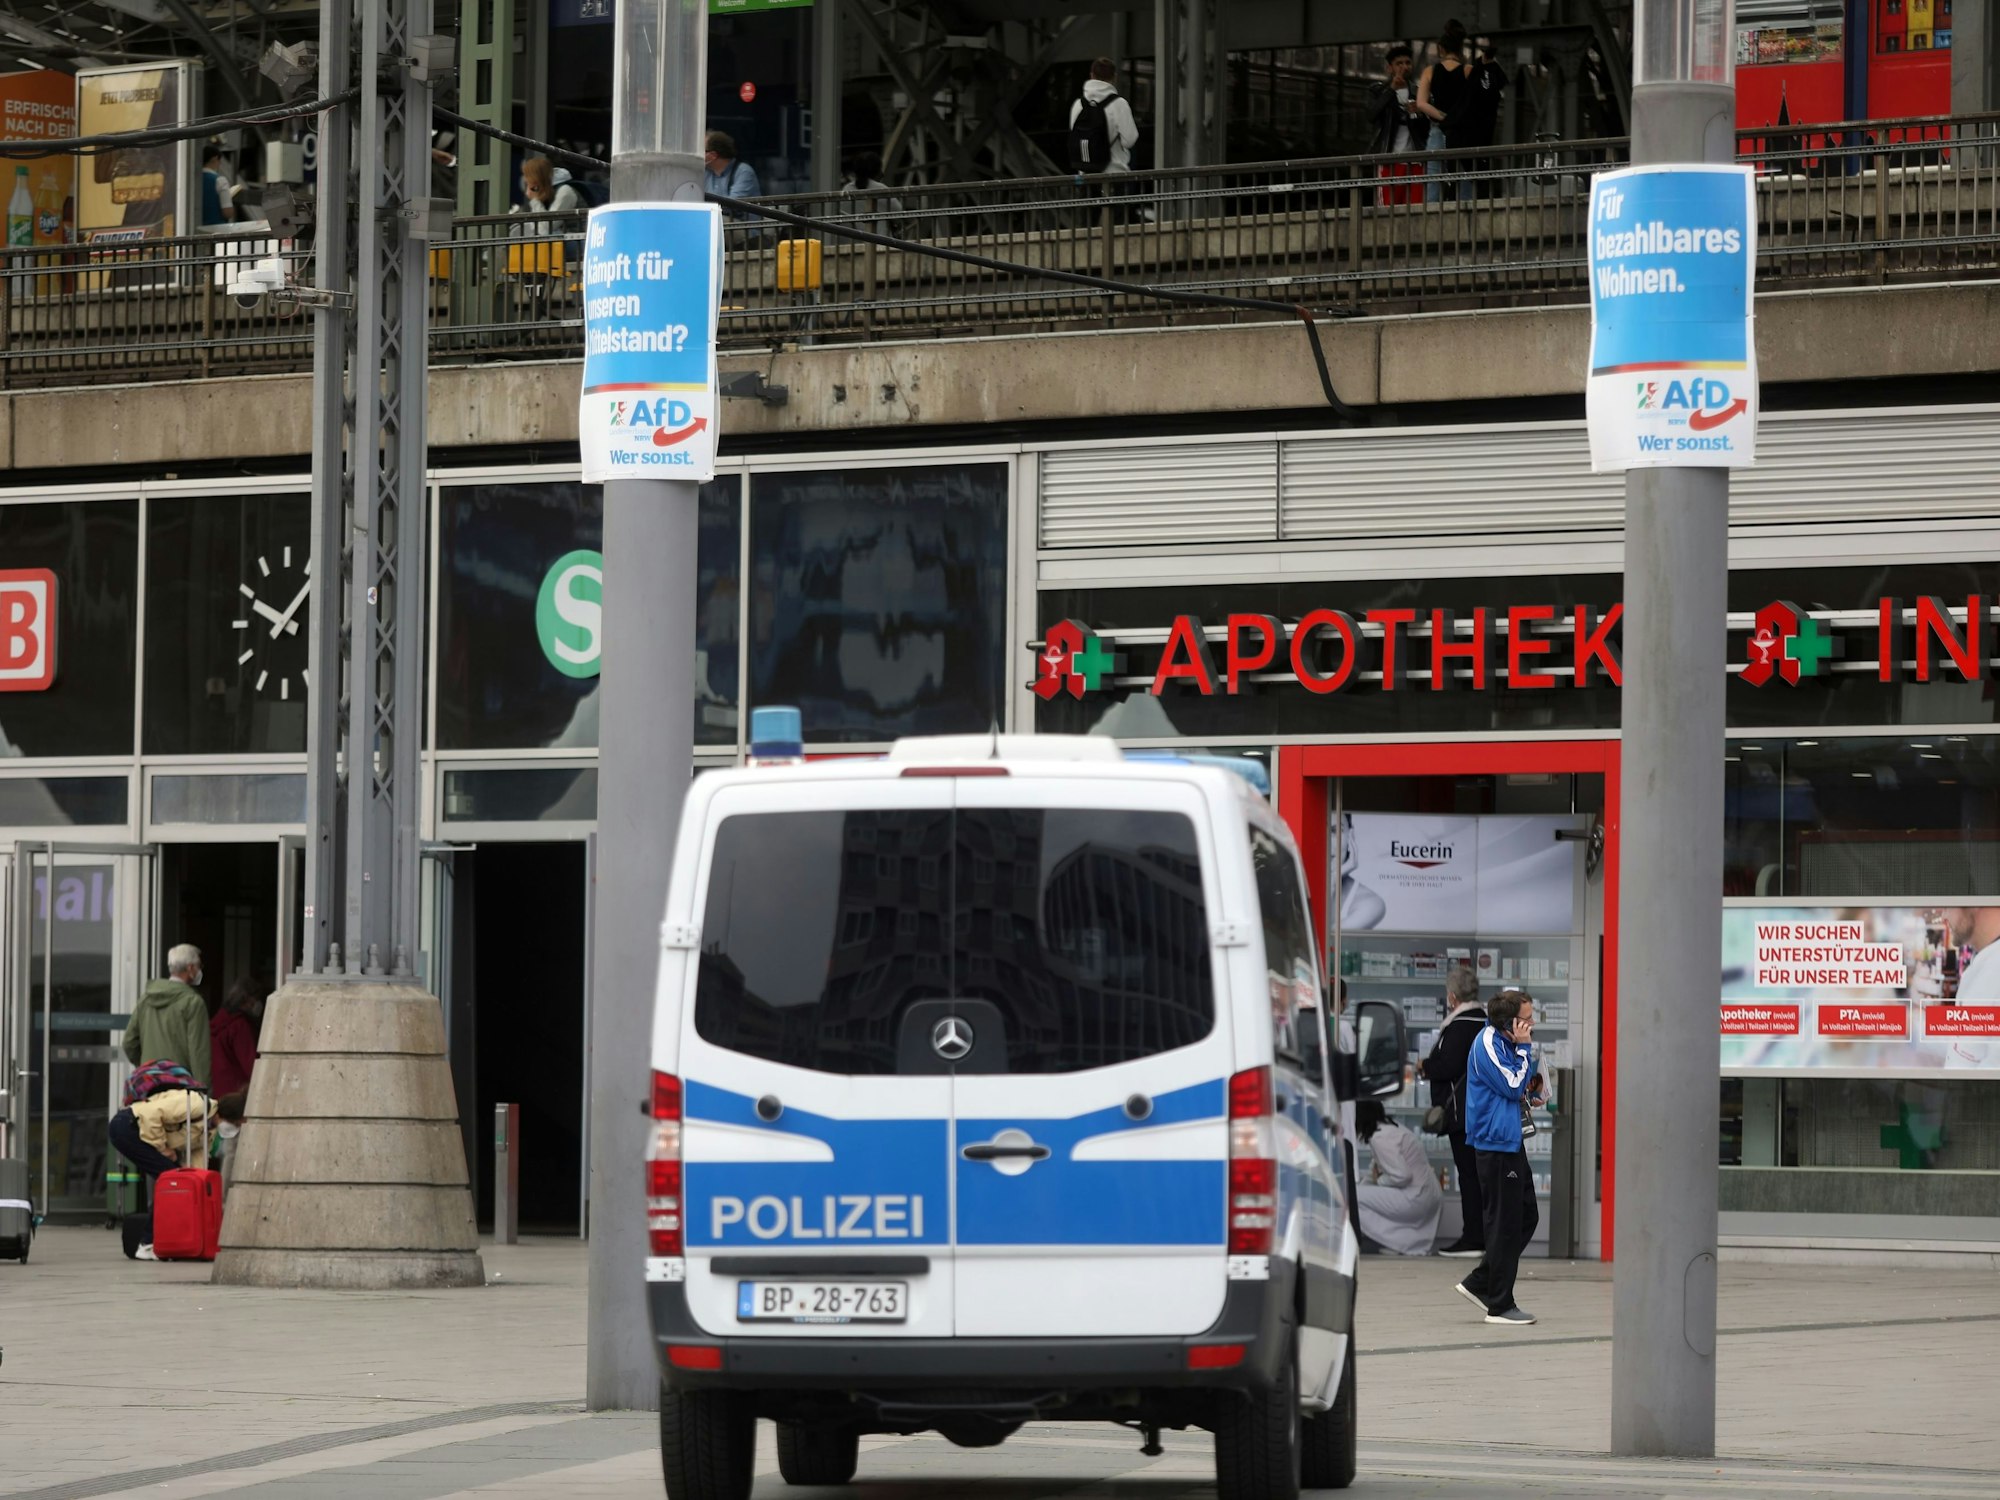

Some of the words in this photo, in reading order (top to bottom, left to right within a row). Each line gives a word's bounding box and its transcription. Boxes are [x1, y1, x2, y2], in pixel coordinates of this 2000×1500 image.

[5, 117, 44, 135] NACH
[1597, 187, 1624, 221] Für
[590, 221, 607, 250] Wer
[1596, 221, 1741, 260] bezahlbares
[587, 252, 631, 289] kämpft
[636, 251, 674, 280] für
[1597, 263, 1686, 299] Wohnen.
[587, 294, 640, 321] unseren
[1661, 377, 1731, 410] AfD
[629, 397, 692, 427] AfD
[1637, 435, 1673, 451] Wer
[1676, 435, 1734, 451] sonst.
[609, 449, 639, 465] Wer
[641, 450, 694, 465] sonst.
[553, 564, 603, 664] S
[1879, 594, 2000, 683] IN
[1391, 840, 1453, 859] Eucerin
[1758, 926, 1790, 940] WIR
[1794, 925, 1861, 940] SUCHEN
[1759, 943, 1900, 962] UNTERSTÜTZUNG
[1759, 966, 1790, 984] FÜR
[1794, 969, 1849, 984] UNSER
[1853, 969, 1904, 984] TEAM!
[1839, 1009, 1861, 1021] PTA
[1946, 1010, 1970, 1021] PKA
[711, 1195, 924, 1239] POLIZEI
[763, 1287, 793, 1312] BP
[813, 1287, 898, 1312] 28-763
